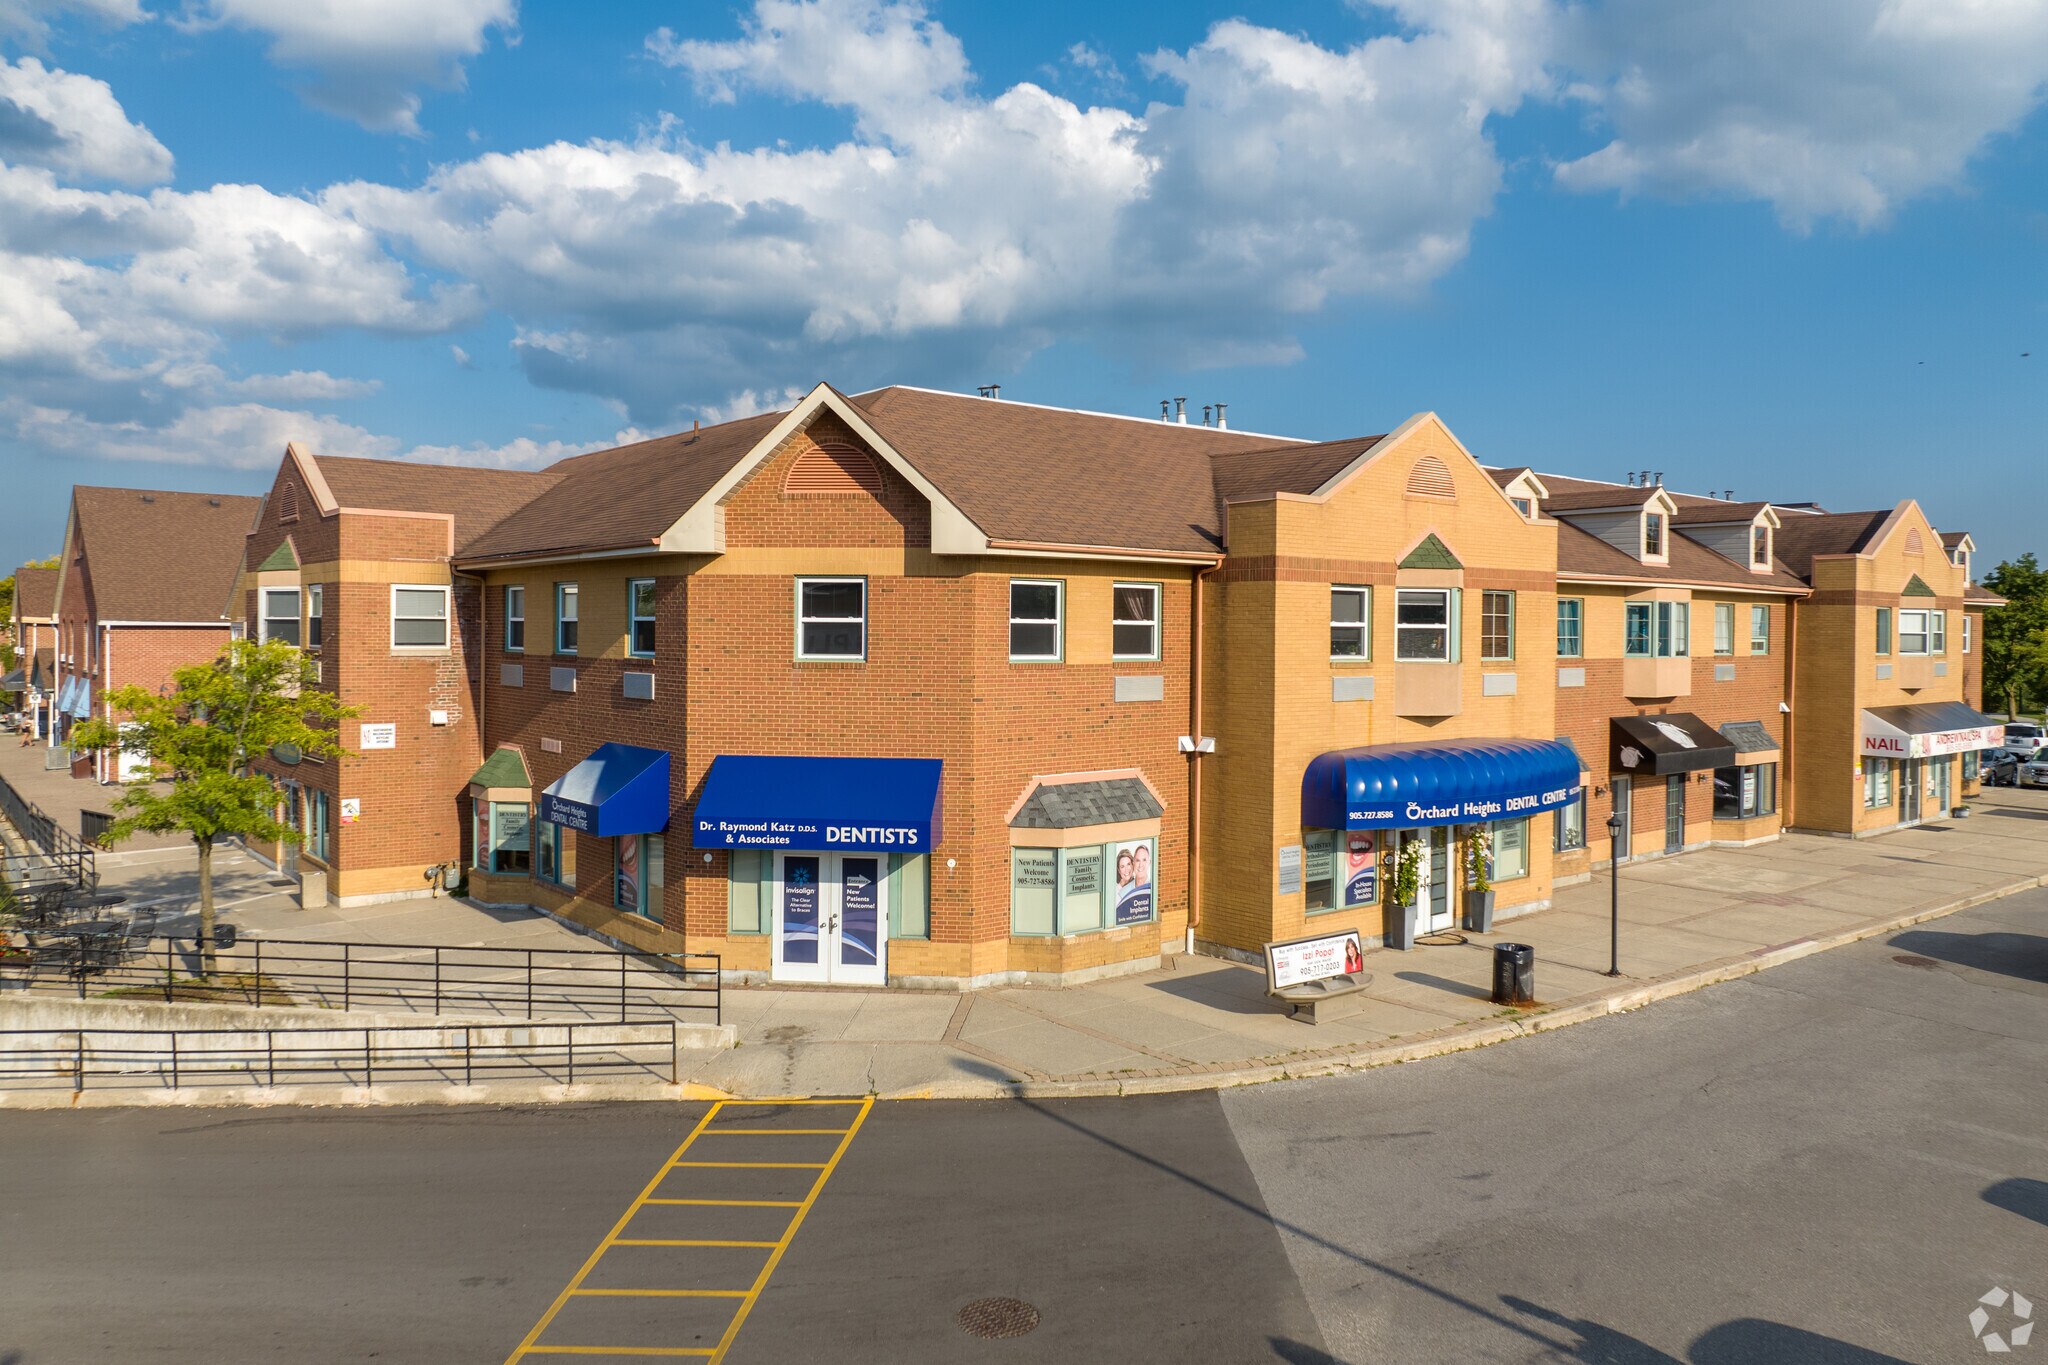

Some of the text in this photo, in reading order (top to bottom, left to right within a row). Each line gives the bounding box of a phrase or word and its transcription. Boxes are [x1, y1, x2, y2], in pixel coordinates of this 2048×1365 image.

[1936, 730, 1982, 745] ANDREW NAIL SPA
[1866, 737, 1904, 752] NAIL
[551, 798, 587, 818] Orchard Heights
[1349, 811, 1394, 820] 905.727.8586
[1406, 802, 1459, 820] Orchard
[1464, 801, 1501, 818] Heights
[1506, 794, 1539, 811] DENTAL
[1542, 789, 1566, 805] CENTRE
[551, 811, 588, 830] DENTAL CENTRE
[700, 821, 716, 831] Dr.
[720, 821, 767, 834] Raymond
[771, 822, 795, 832] Katz
[826, 826, 918, 845] DENTISTS
[725, 834, 790, 844] & Associates
[1032, 859, 1055, 867] Patients
[1067, 856, 1100, 866] DENTISTRY
[1023, 868, 1049, 876] Welcome
[1074, 866, 1093, 874] Family
[1017, 877, 1055, 886] 905-727-8586
[785, 887, 815, 895] invisalign
[1072, 883, 1095, 892] Implants
[1134, 898, 1149, 907] Dental
[1300, 961, 1340, 975] 905-717-0203
